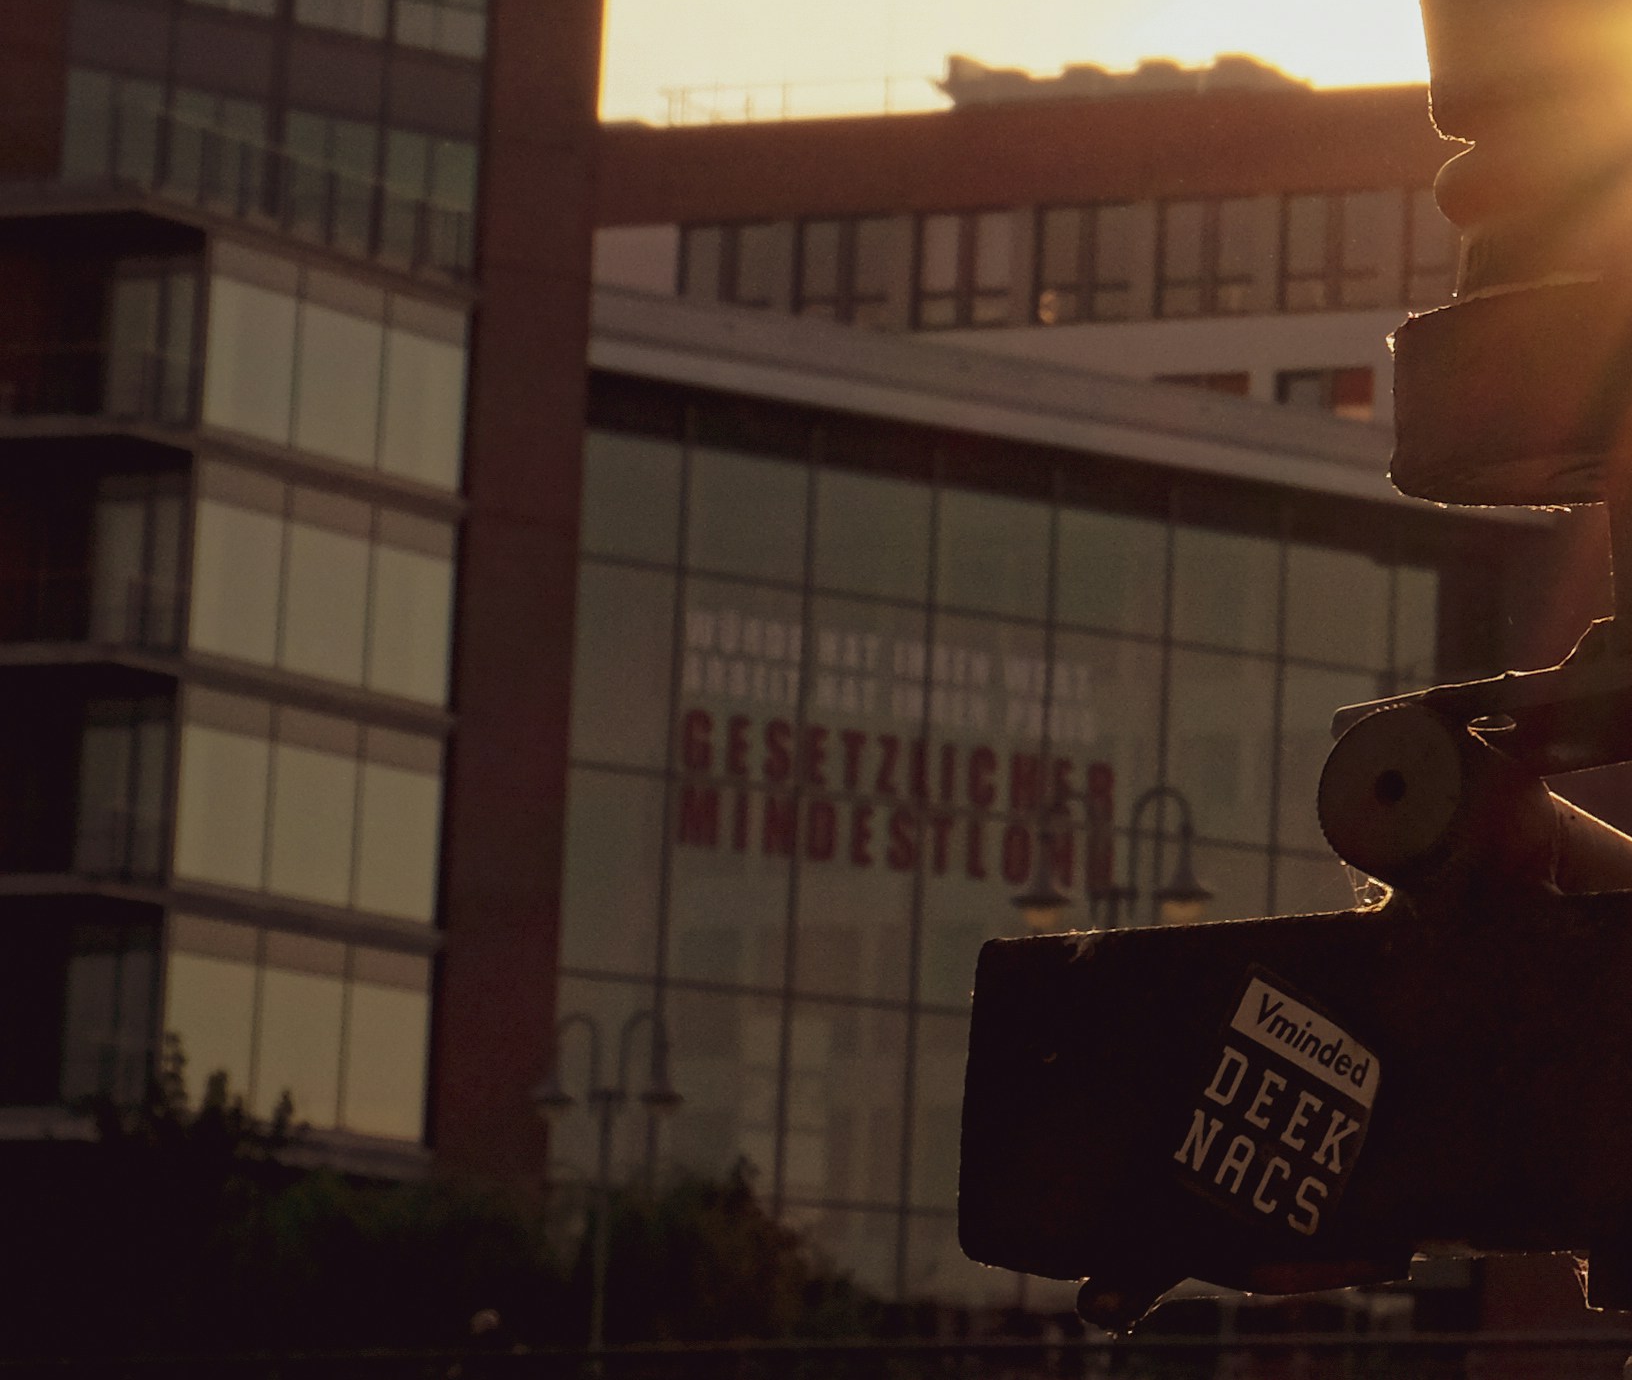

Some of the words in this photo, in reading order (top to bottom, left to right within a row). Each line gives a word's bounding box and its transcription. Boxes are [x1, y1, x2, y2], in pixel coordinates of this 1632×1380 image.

[681, 709, 1115, 825] GESETZLICHER
[1255, 992, 1371, 1088] Vminded
[1203, 1044, 1361, 1175] DEEK
[1173, 1108, 1329, 1237] NACS
